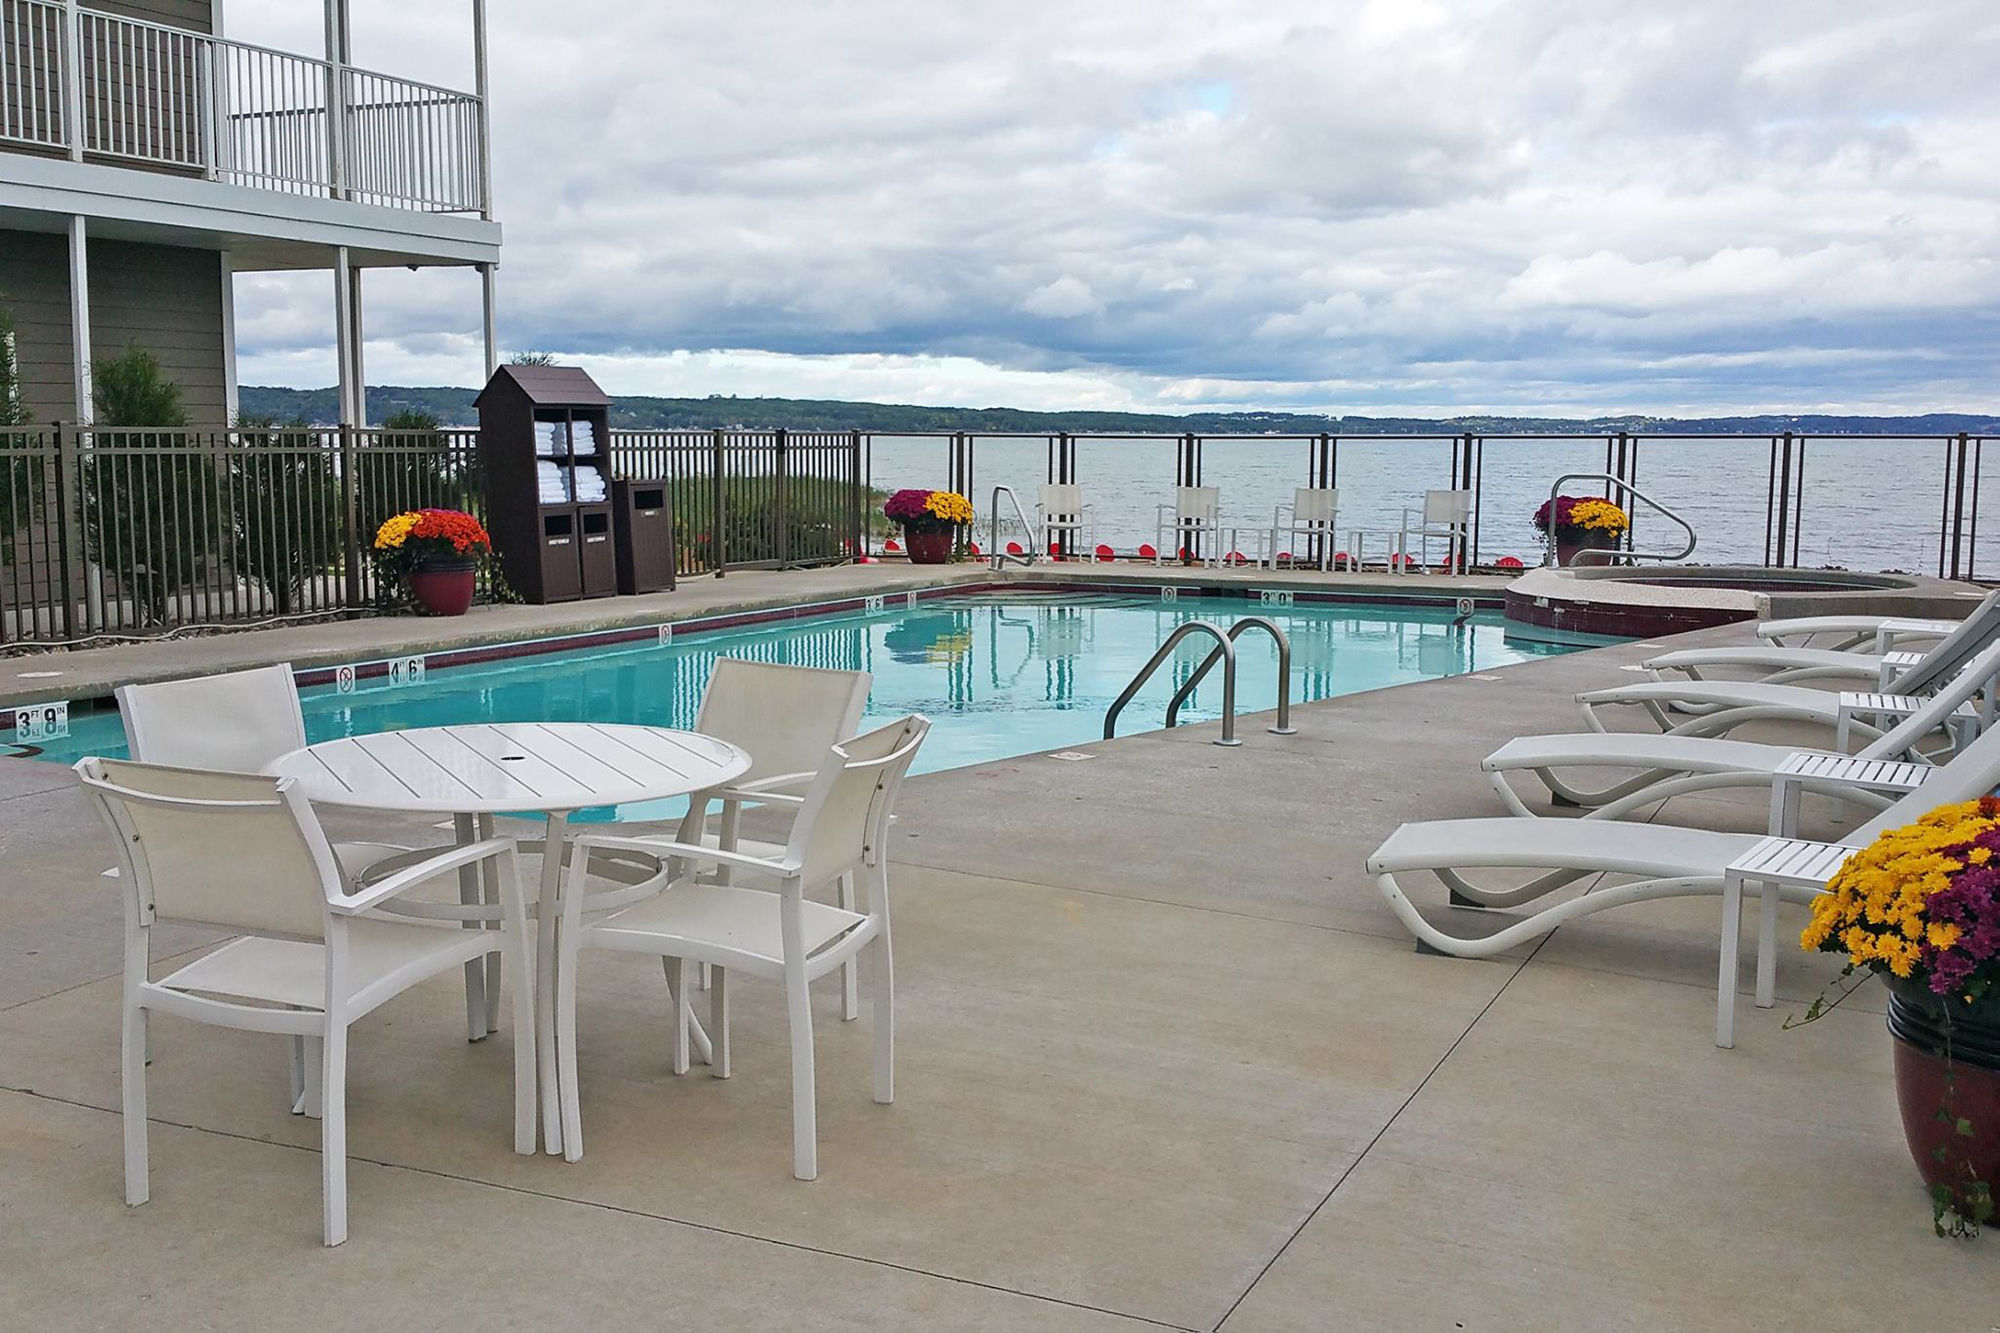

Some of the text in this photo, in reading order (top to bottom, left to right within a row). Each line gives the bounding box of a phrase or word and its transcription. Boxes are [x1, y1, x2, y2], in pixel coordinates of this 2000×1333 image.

[19, 711, 31, 728] 3
[31, 710, 39, 718] FT
[56, 706, 65, 714] IN
